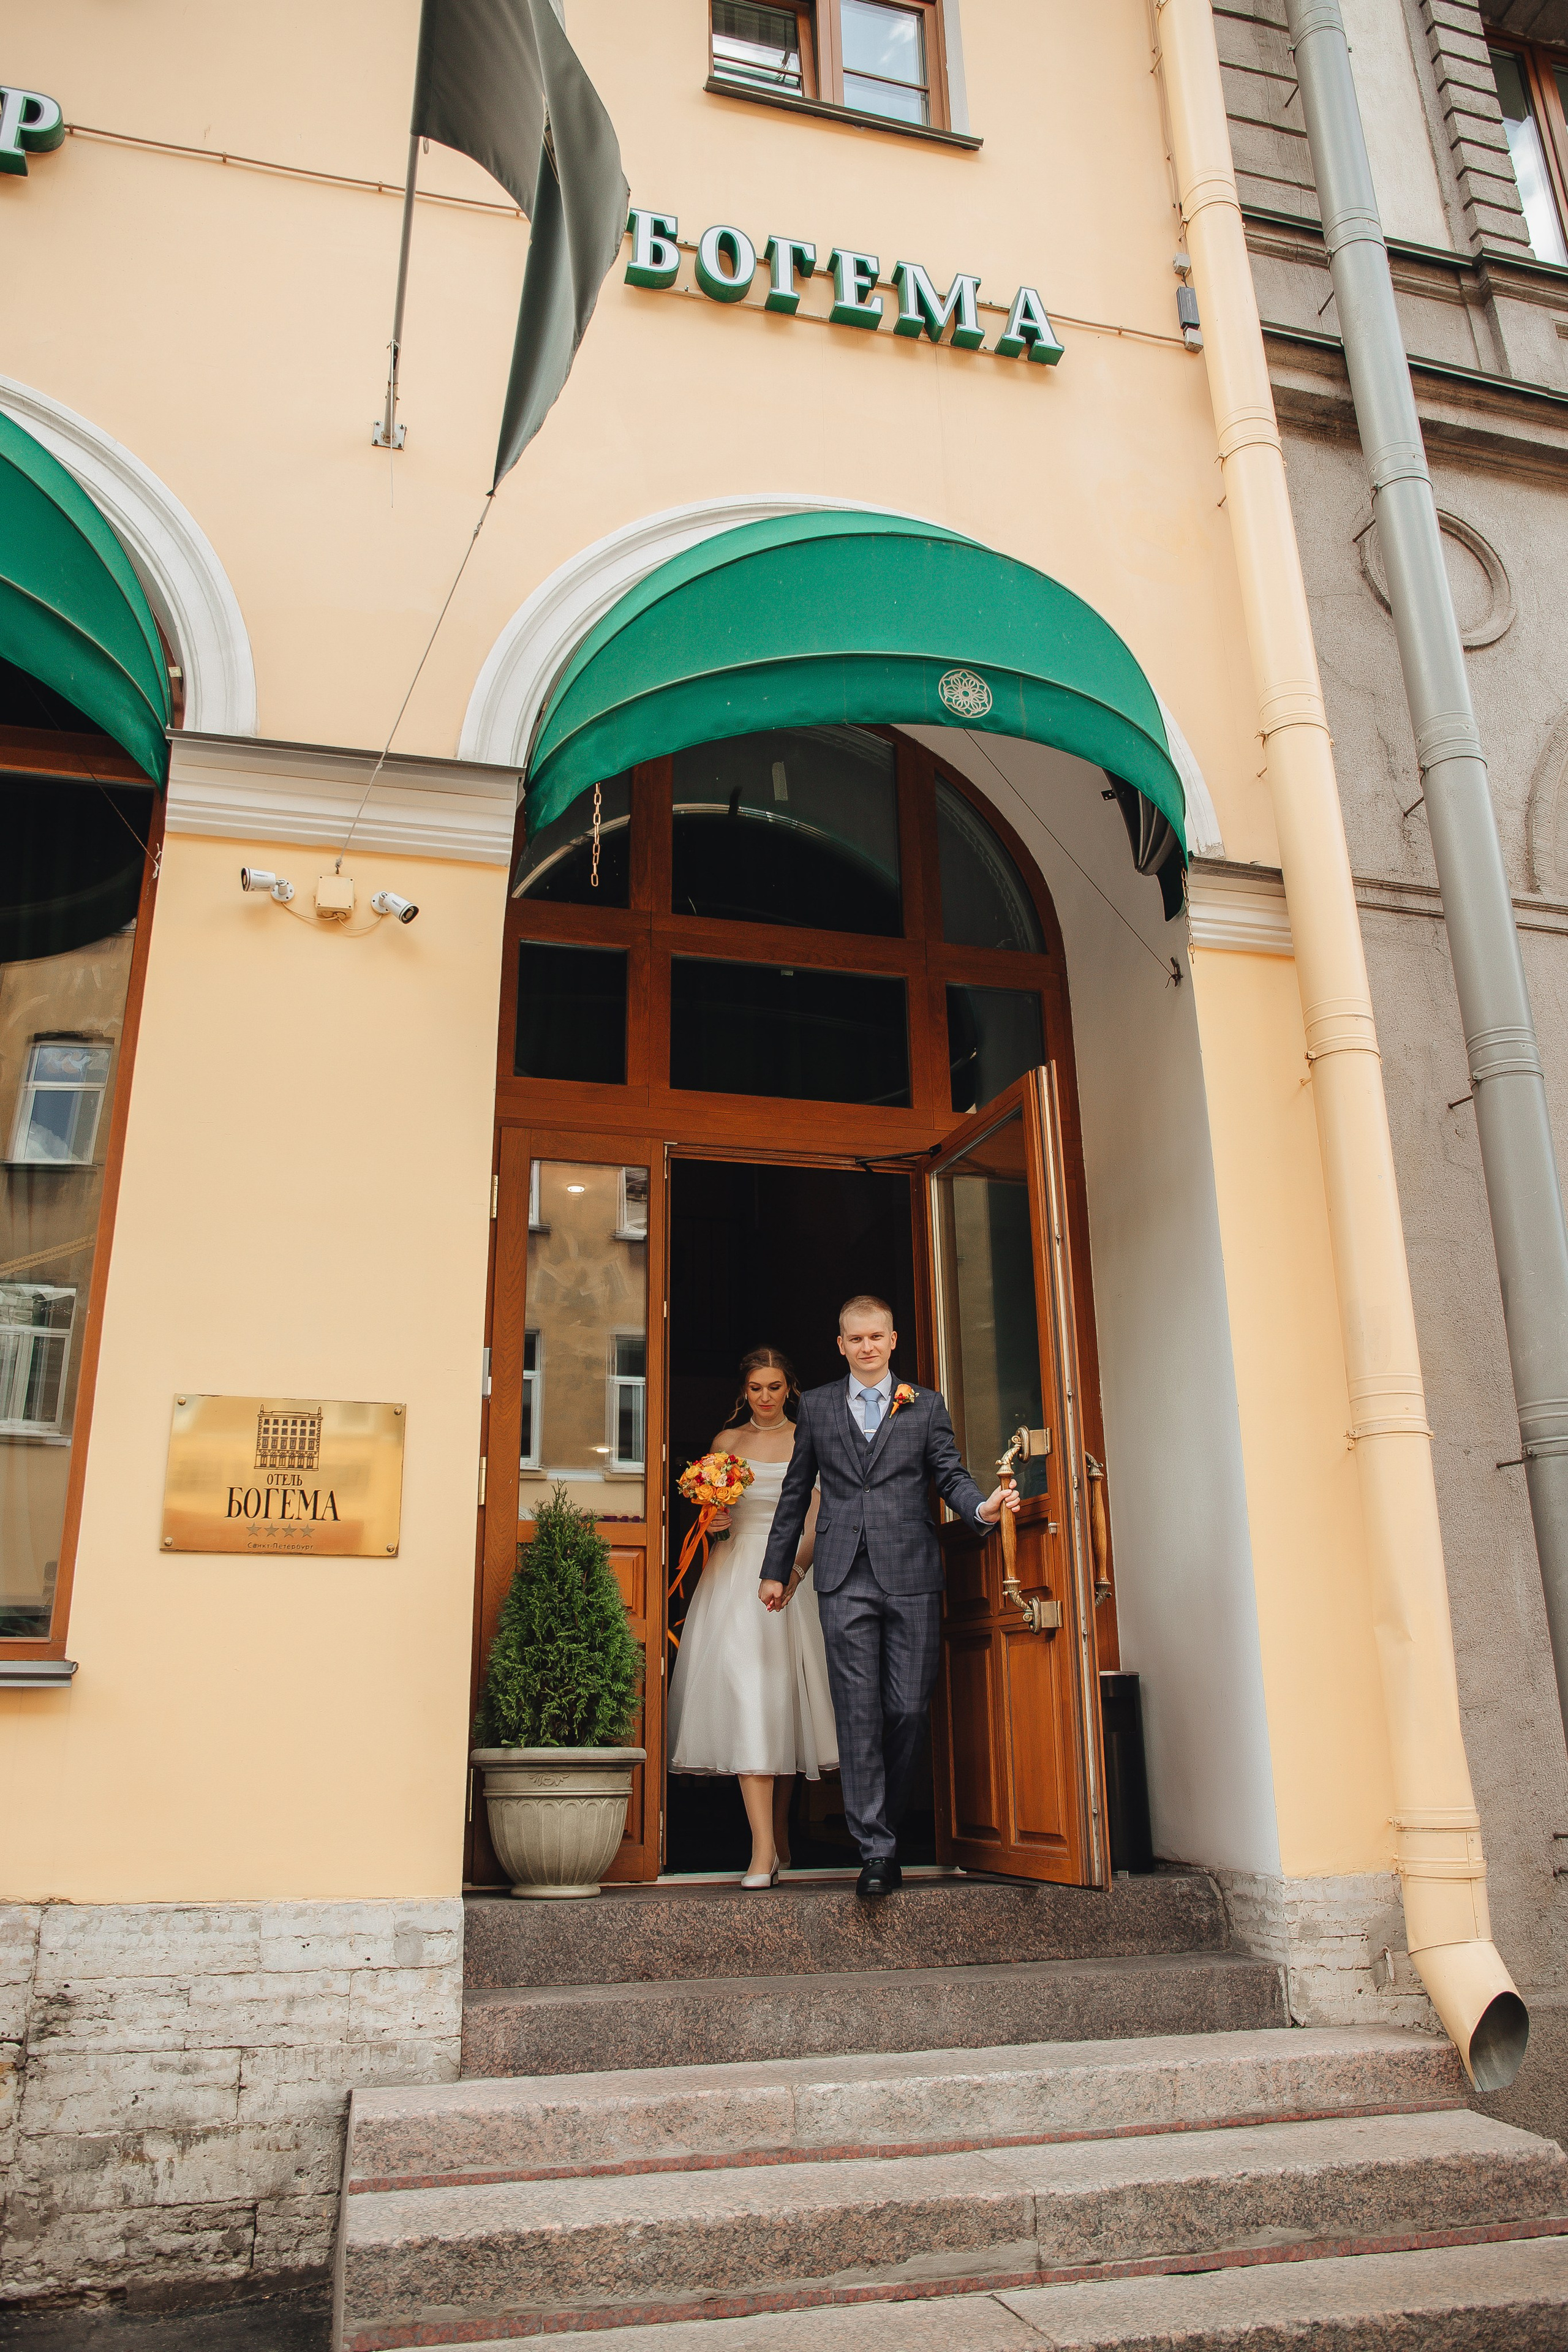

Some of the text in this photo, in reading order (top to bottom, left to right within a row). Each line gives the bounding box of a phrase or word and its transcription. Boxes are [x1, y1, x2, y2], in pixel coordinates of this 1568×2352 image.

[624, 208, 1065, 366] БОГЕМА
[266, 1473, 303, 1487] ОТЕЛЬ
[224, 1487, 341, 1521] БОГЕМА
[247, 1542, 314, 1551] Санкт-Петербург
